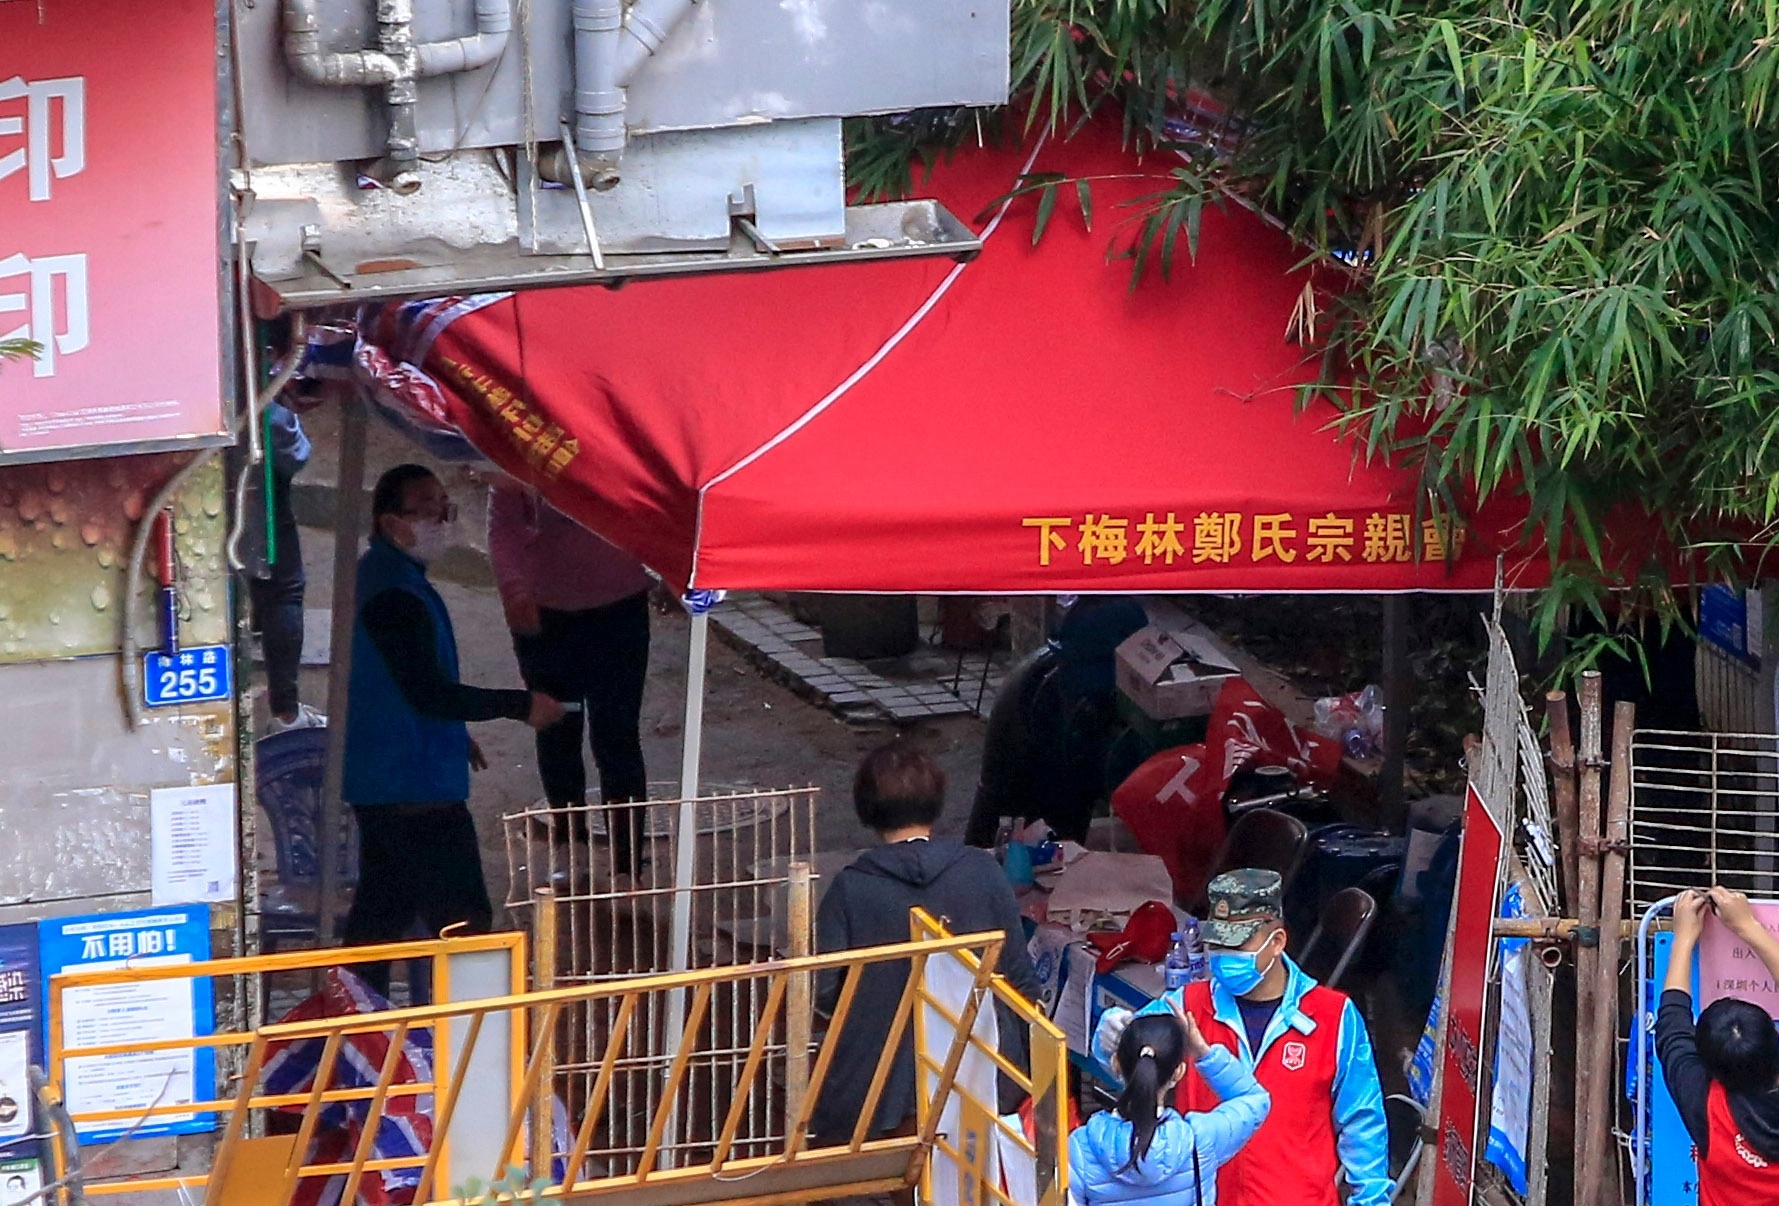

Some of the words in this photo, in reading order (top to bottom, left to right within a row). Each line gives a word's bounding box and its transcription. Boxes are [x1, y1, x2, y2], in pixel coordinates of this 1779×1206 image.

[0, 75, 88, 202] 印
[0, 252, 92, 378] 印
[159, 667, 217, 699] 255
